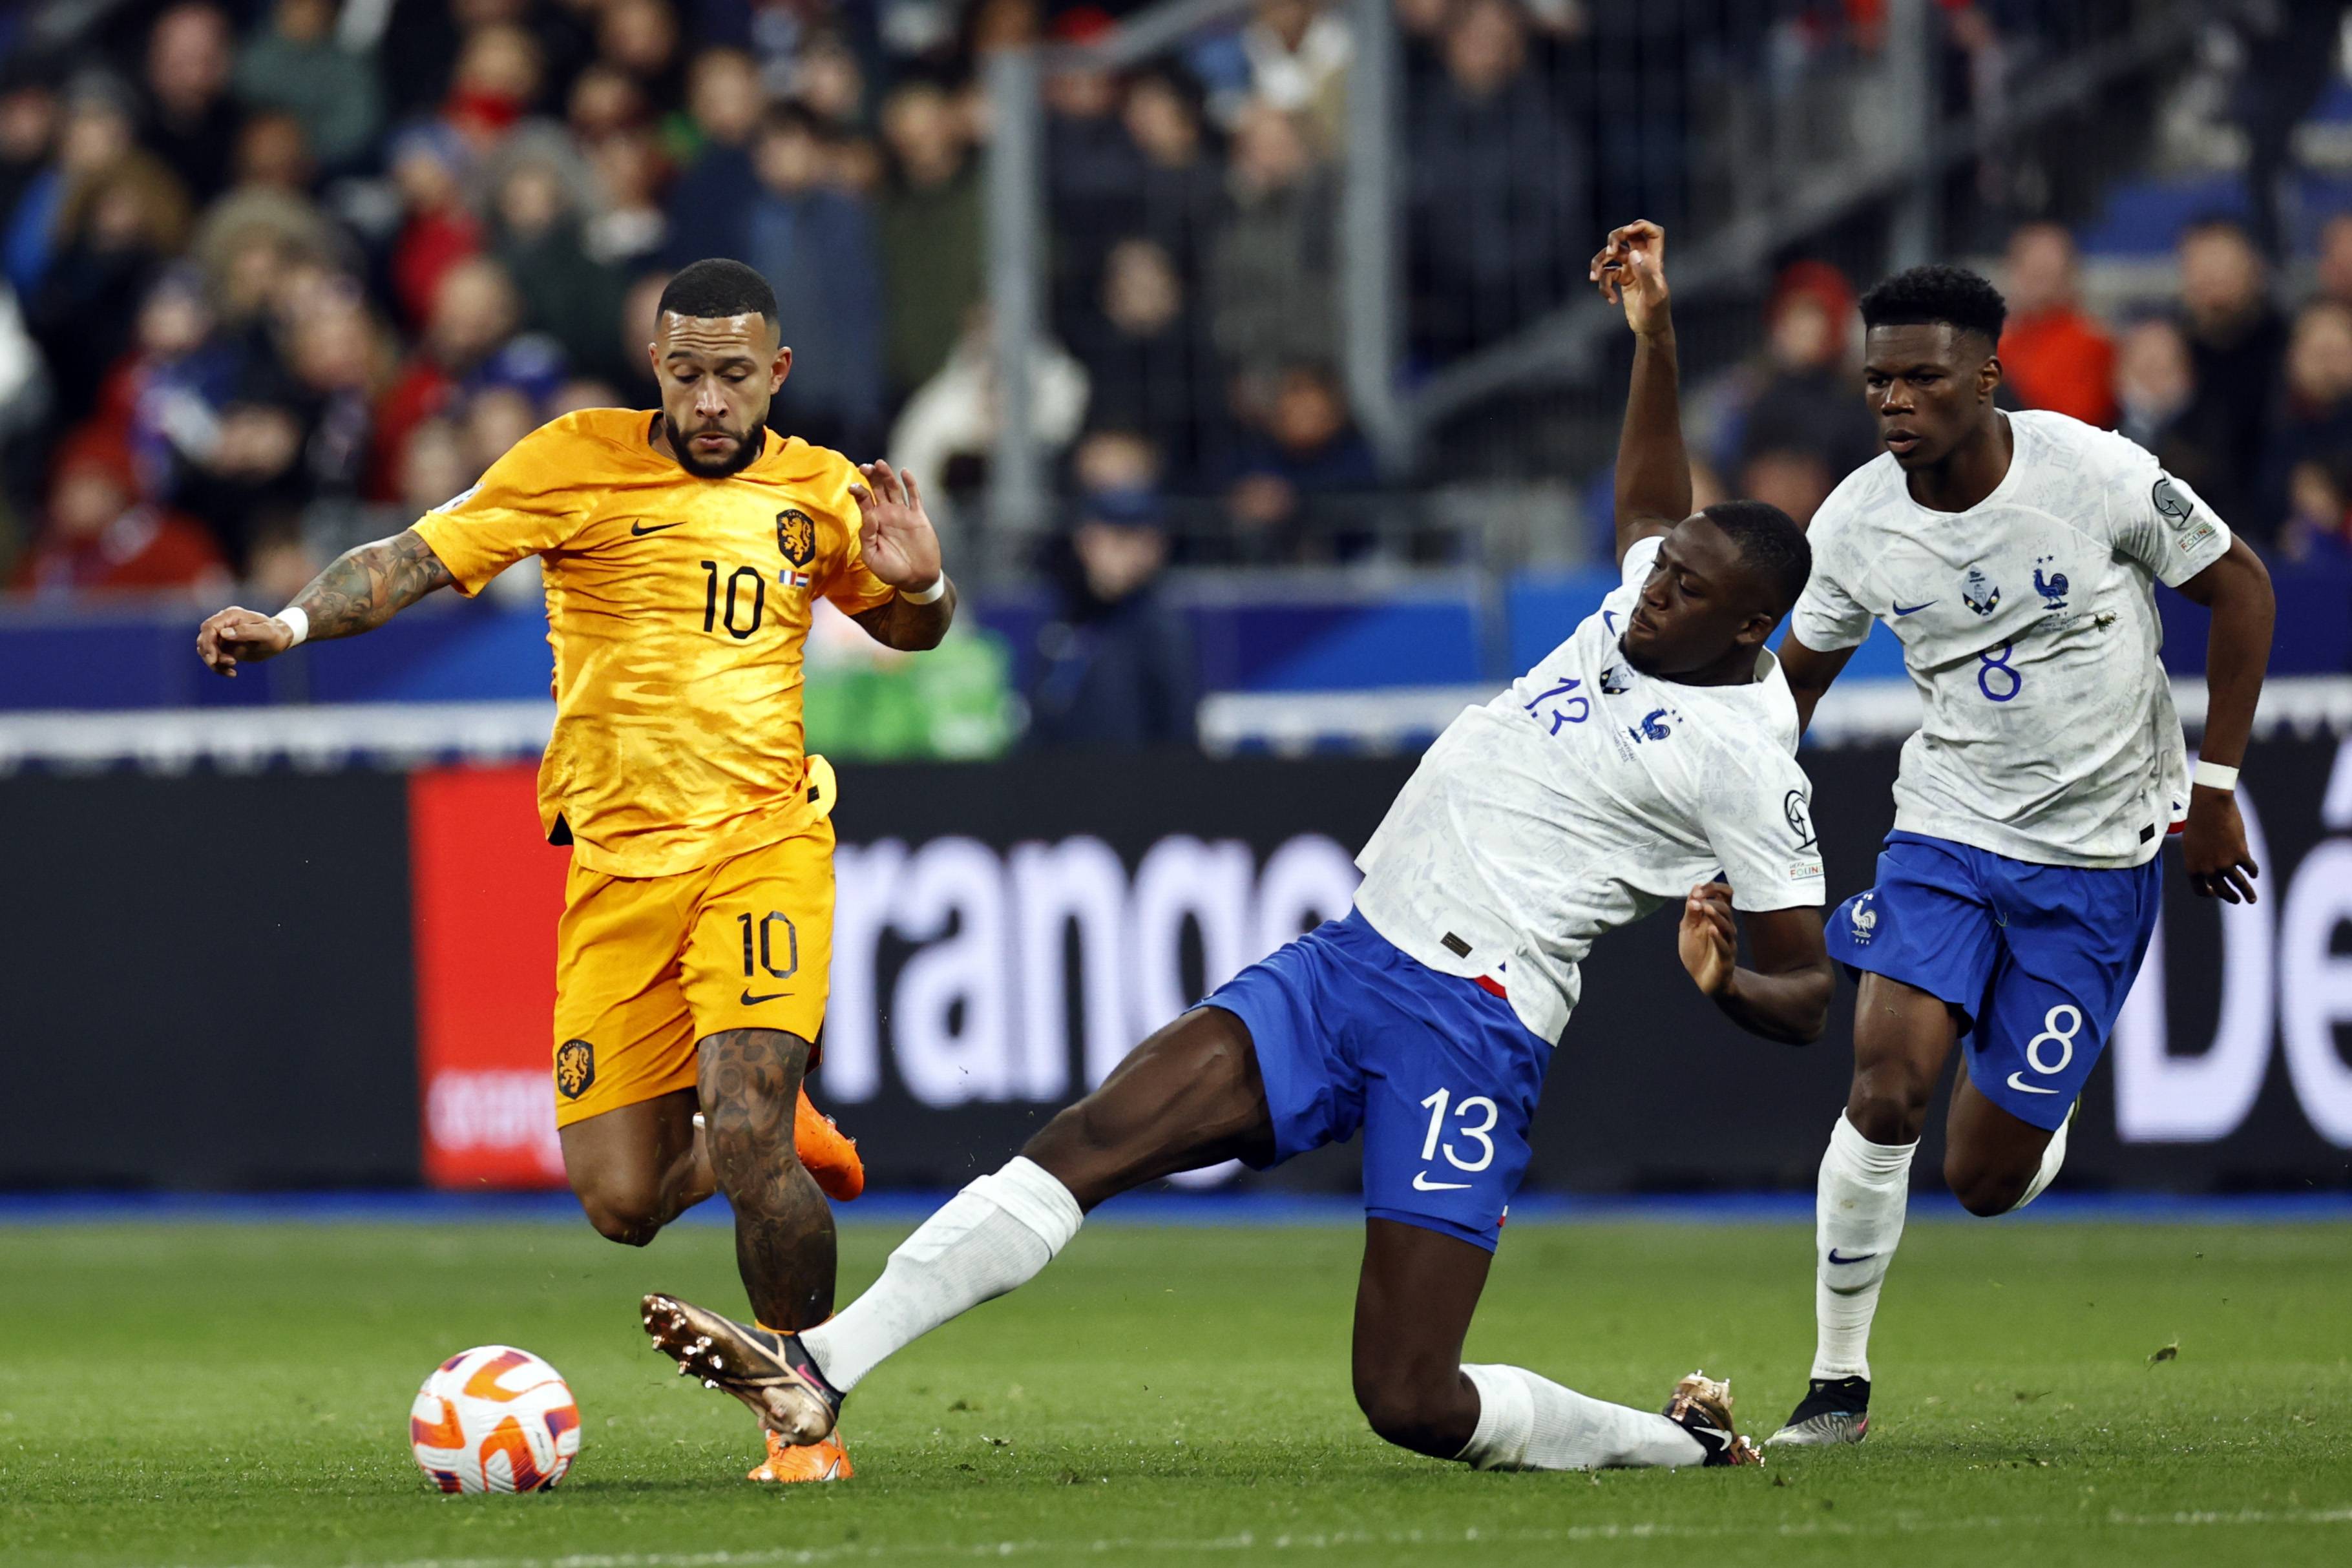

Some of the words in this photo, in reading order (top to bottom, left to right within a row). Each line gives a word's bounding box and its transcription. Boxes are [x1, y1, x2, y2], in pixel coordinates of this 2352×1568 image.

[700, 560, 765, 640] 10
[1978, 638, 2021, 702] 8
[1523, 677, 1590, 737] 13
[737, 911, 798, 979] 10
[819, 832, 1367, 1187] rang
[2026, 1004, 2082, 1074] 8
[1420, 1087, 1498, 1172] 13
